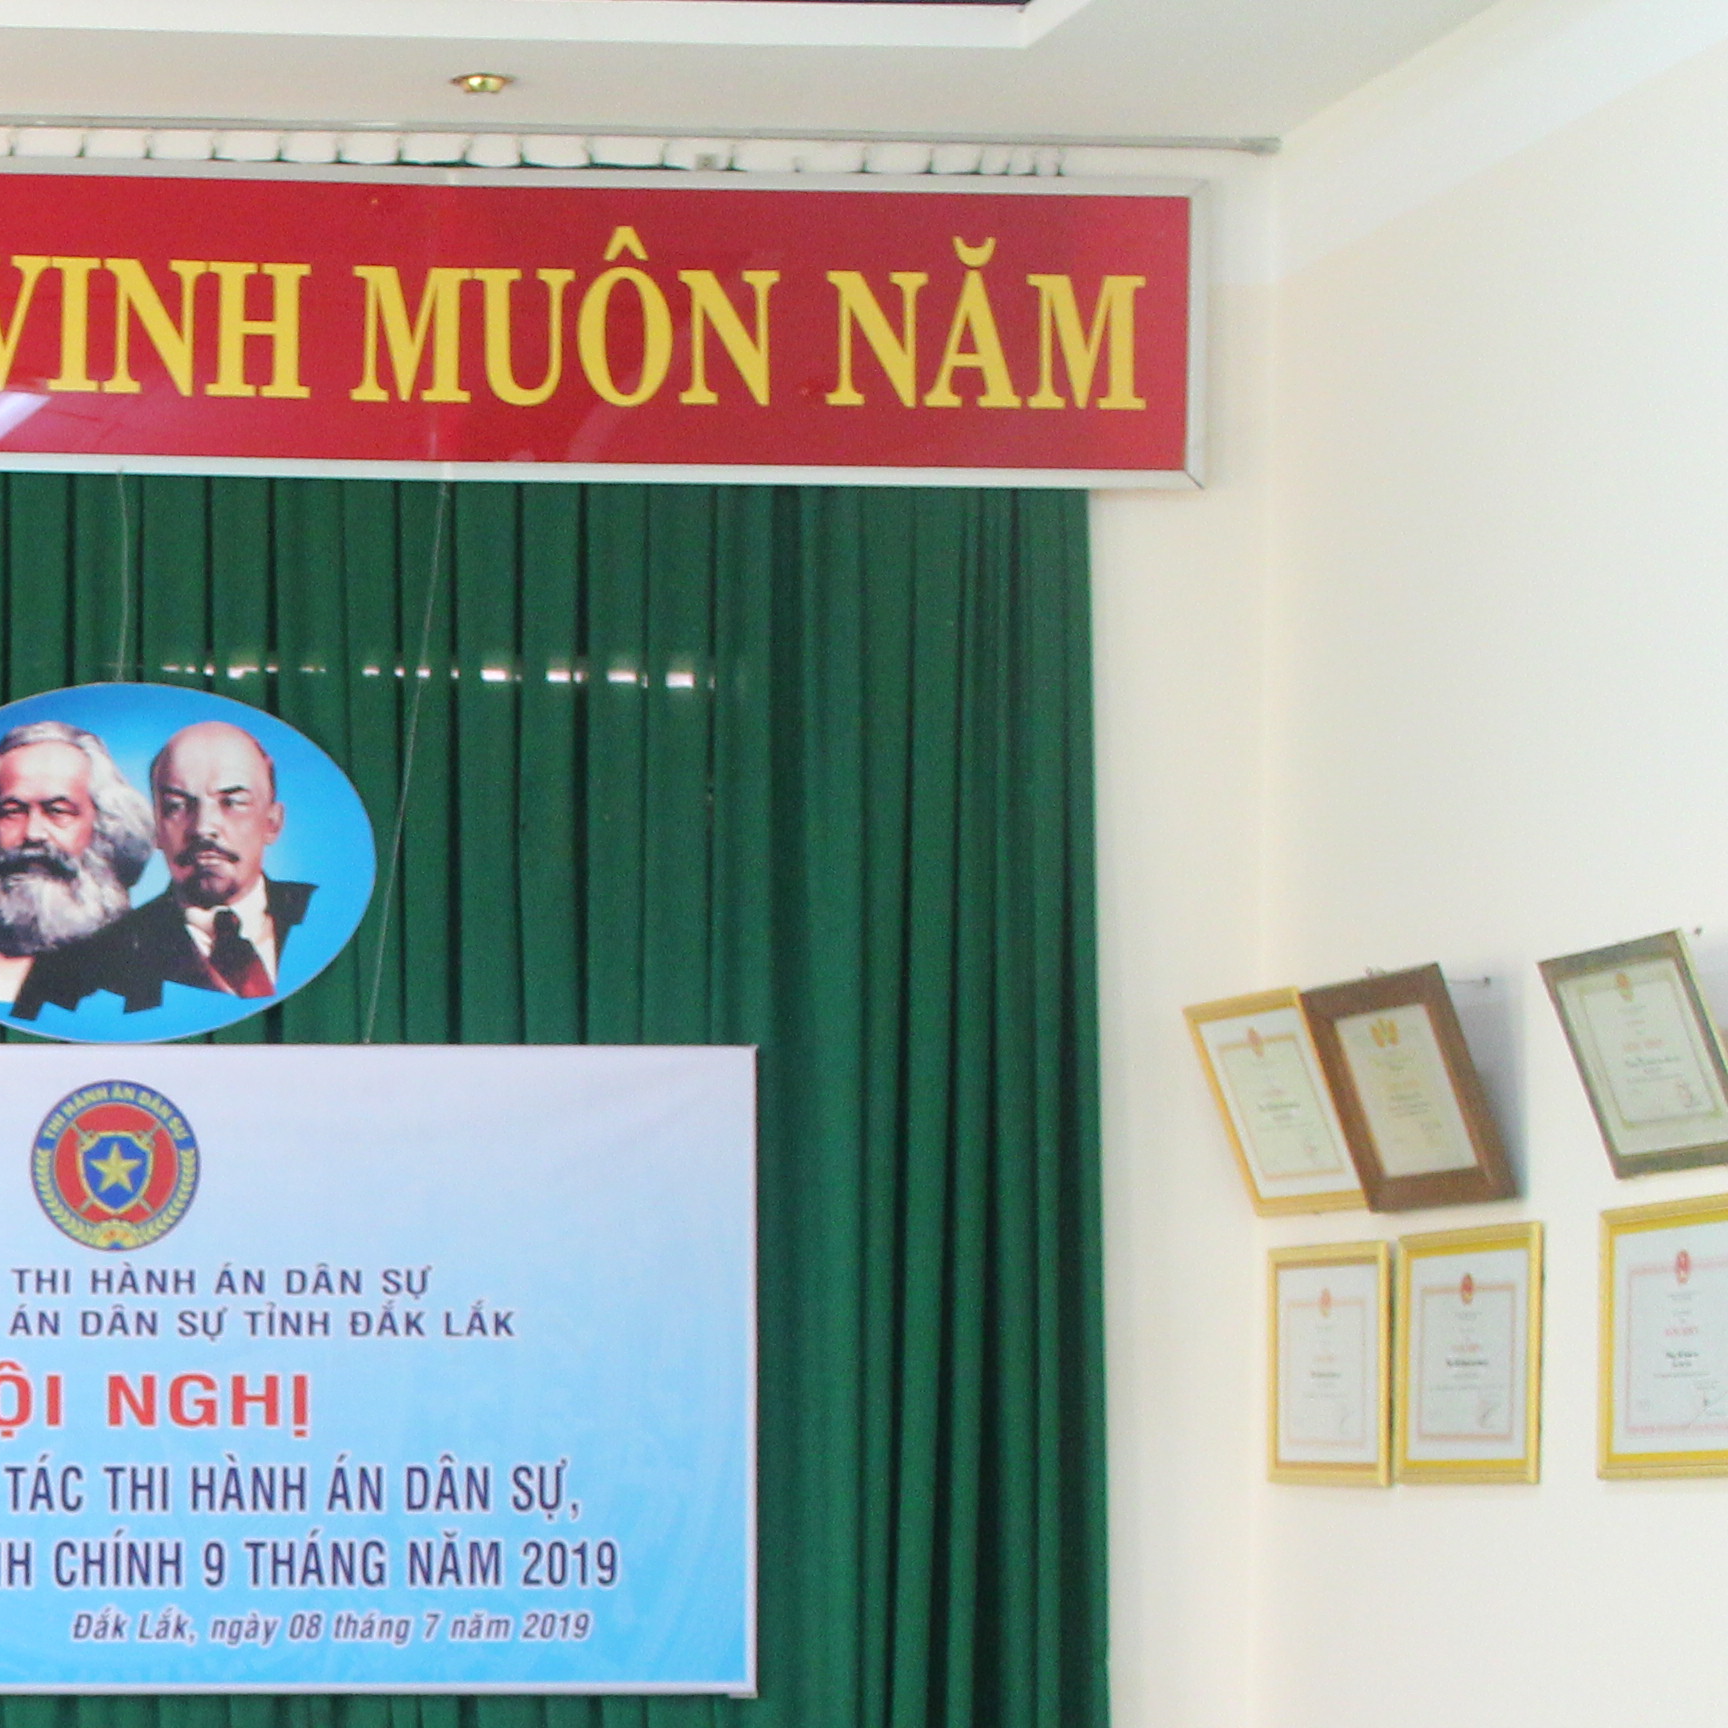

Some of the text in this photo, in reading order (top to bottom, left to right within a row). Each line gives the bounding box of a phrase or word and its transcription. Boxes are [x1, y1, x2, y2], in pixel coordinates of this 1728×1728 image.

[350, 225, 780, 408] MUÔN
[826, 236, 1147, 411] NĂM
[11, 1267, 72, 1295] THI
[90, 1262, 196, 1295] HÀNH
[214, 1262, 265, 1295] ÁN
[285, 1263, 362, 1296] DÂN
[381, 1266, 432, 1300] SỰ
[9, 1303, 60, 1337] ÁN
[80, 1305, 158, 1337] DÂN
[177, 1307, 227, 1342] SỰ
[244, 1302, 330, 1337] TỈNH
[348, 1301, 426, 1337] ĐẮK
[443, 1300, 515, 1338] LẮK
[106, 1372, 312, 1438] NGHỊ
[3, 1453, 84, 1513] TÁC
[102, 1464, 170, 1512] THI
[190, 1453, 307, 1512] HÀNH
[326, 1453, 384, 1512] ÁN
[405, 1453, 491, 1512] DÂN
[511, 1458, 580, 1521] SỰ,
[53, 1528, 182, 1588] CHÍNH
[202, 1540, 226, 1588] 9
[243, 1528, 386, 1588] THÁNG
[407, 1530, 501, 1587] NĂM
[521, 1539, 618, 1587] 2019
[72, 1607, 592, 1647] Đắk Lắk, ngày 08 tháng 7 năm 2019
